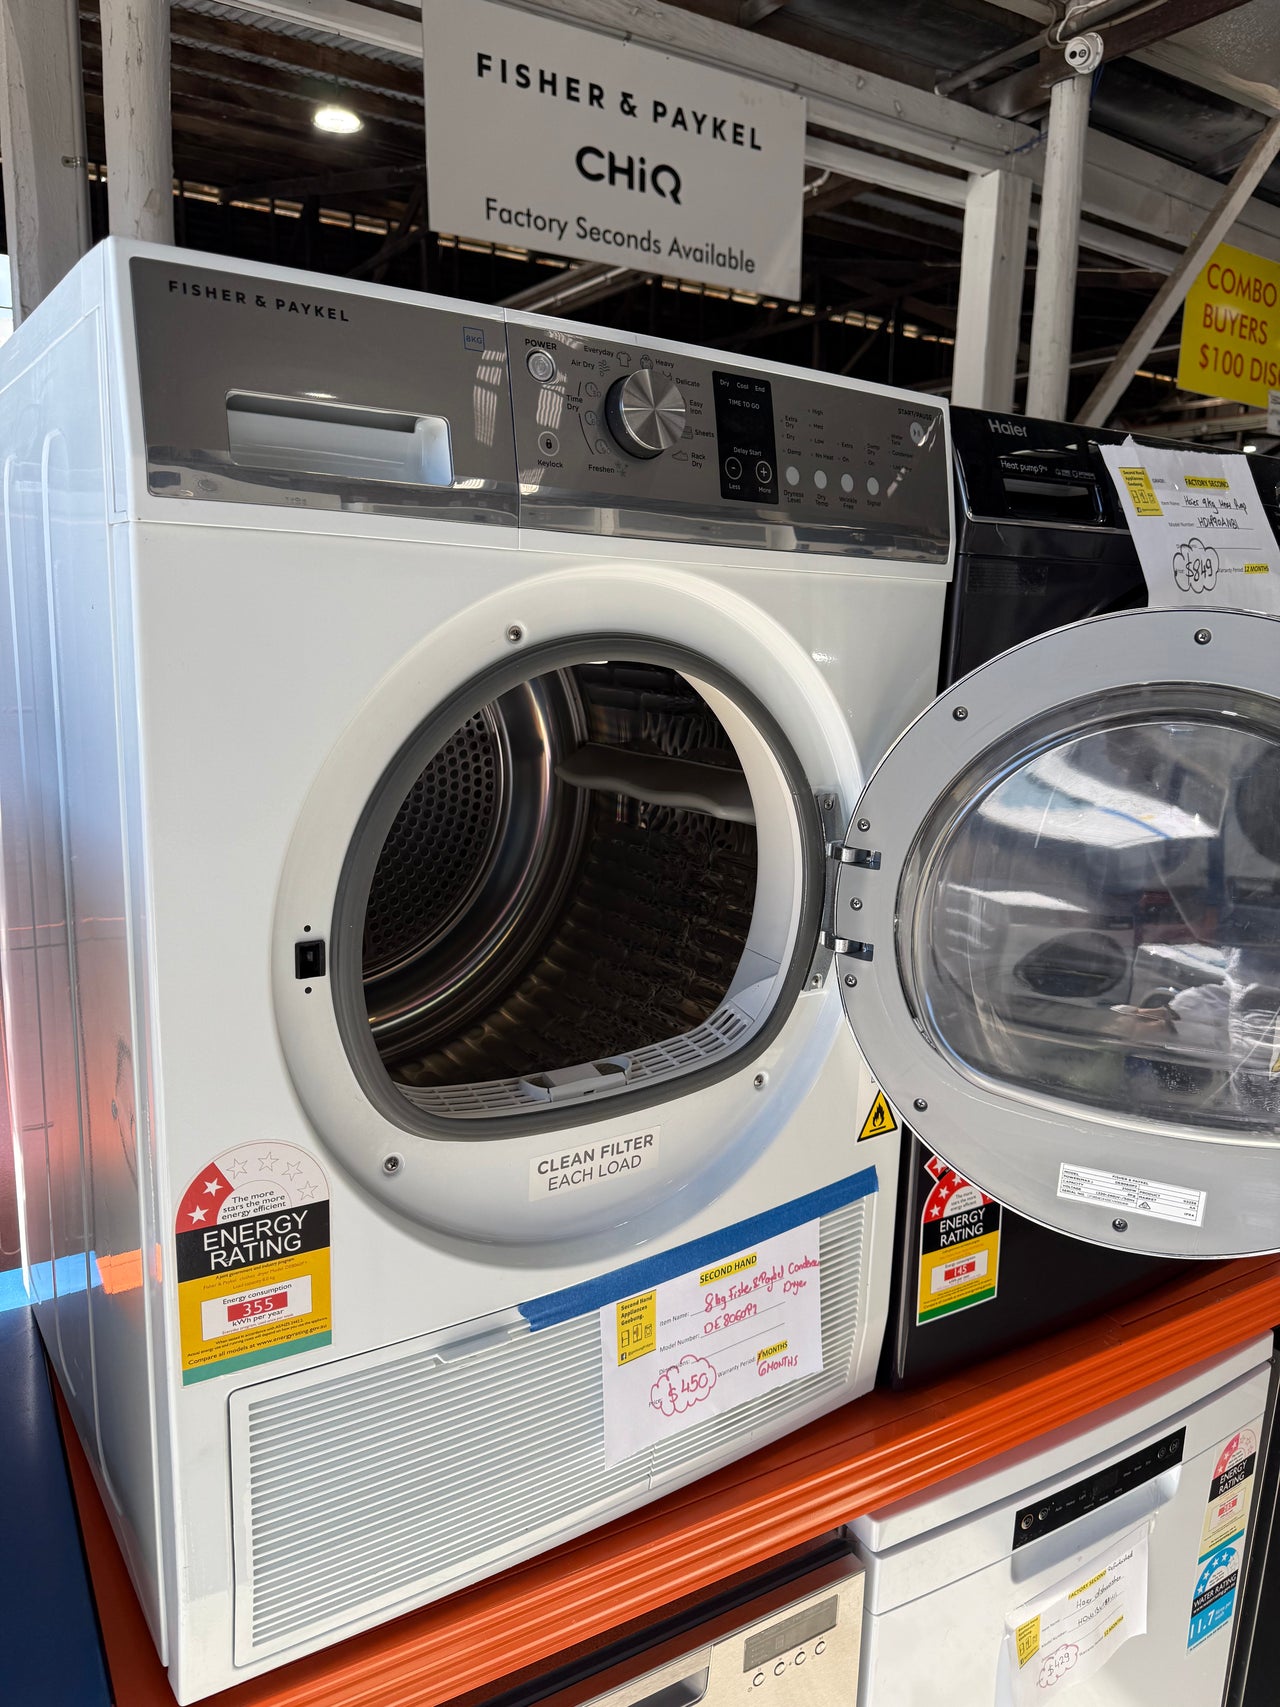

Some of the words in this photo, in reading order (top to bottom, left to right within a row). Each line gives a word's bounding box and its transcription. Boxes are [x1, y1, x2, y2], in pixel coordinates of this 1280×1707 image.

[476, 52, 604, 109] FISHER
[619, 92, 638, 118] &
[653, 100, 762, 151] PAYKEL
[576, 146, 682, 204] CHiQ
[485, 197, 568, 241] Factory
[576, 216, 662, 255] Seconds
[668, 237, 755, 274] Available
[1207, 263, 1277, 307] COMBO
[169, 280, 247, 304] FISHER
[256, 295, 267, 308] &
[276, 298, 349, 322] PAYKEL
[1203, 303, 1268, 345] BUYERS
[466, 334, 483, 345] 8KG
[525, 339, 557, 350] POWER
[584, 345, 614, 357] Everyday
[582, 361, 595, 369] Dry
[655, 359, 674, 368] Heavy
[1199, 343, 1244, 378] $100
[1250, 358, 1280, 387] DIS
[676, 378, 700, 387] Delicate
[566, 395, 583, 403] Time
[567, 403, 579, 412] Dry
[729, 399, 741, 407] TIME
[695, 429, 714, 438] Sheets
[988, 419, 1027, 437] Haier
[734, 447, 748, 456] Delay
[538, 460, 563, 468] Keylock
[588, 464, 614, 473] Freshen
[1001, 460, 1019, 470] Heat
[1020, 465, 1038, 474] pump
[1185, 478, 1207, 486] FACTORY
[1186, 552, 1213, 586] $849
[1250, 564, 1269, 572] MONTHS
[538, 1149, 594, 1175] CLEAN
[601, 1134, 653, 1159] FILTER
[548, 1167, 593, 1191] EACH
[599, 1155, 642, 1177] LOAD
[223, 1204, 244, 1213] stars
[262, 1195, 285, 1204] more
[251, 1190, 274, 1200] more
[222, 1209, 251, 1221] energy
[253, 1201, 286, 1213] efficient
[940, 1208, 985, 1232] ENERGY
[204, 1210, 308, 1252] ENERGY
[940, 1223, 984, 1247] RATING
[210, 1233, 302, 1270] RATING
[700, 1264, 733, 1284] SECOND
[734, 1255, 757, 1272] HAND
[954, 1266, 967, 1277] 145
[223, 1295, 246, 1305] Energy
[248, 1283, 292, 1299] consumption
[620, 1301, 638, 1311] Second
[639, 1295, 653, 1305] Hand
[243, 1297, 274, 1317] 355
[621, 1305, 648, 1318] Appliances
[232, 1316, 251, 1327] kWh
[268, 1309, 284, 1319] year
[660, 1318, 672, 1327] Item
[672, 1312, 690, 1323] Name:
[660, 1340, 677, 1353] Model
[677, 1334, 699, 1348] Number:
[188, 1354, 217, 1365] Compare
[227, 1345, 248, 1355] models
[718, 1365, 739, 1378] Warranty
[740, 1357, 756, 1370] Period:
[762, 1340, 788, 1357] MONTHS
[668, 1383, 678, 1403] $
[681, 1373, 709, 1394] 450
[1220, 1460, 1247, 1484] ENERGY
[1219, 1472, 1245, 1494] RATING
[1193, 1590, 1214, 1608] WATER
[1215, 1573, 1237, 1593] RATING
[1048, 1652, 1070, 1676] $429
